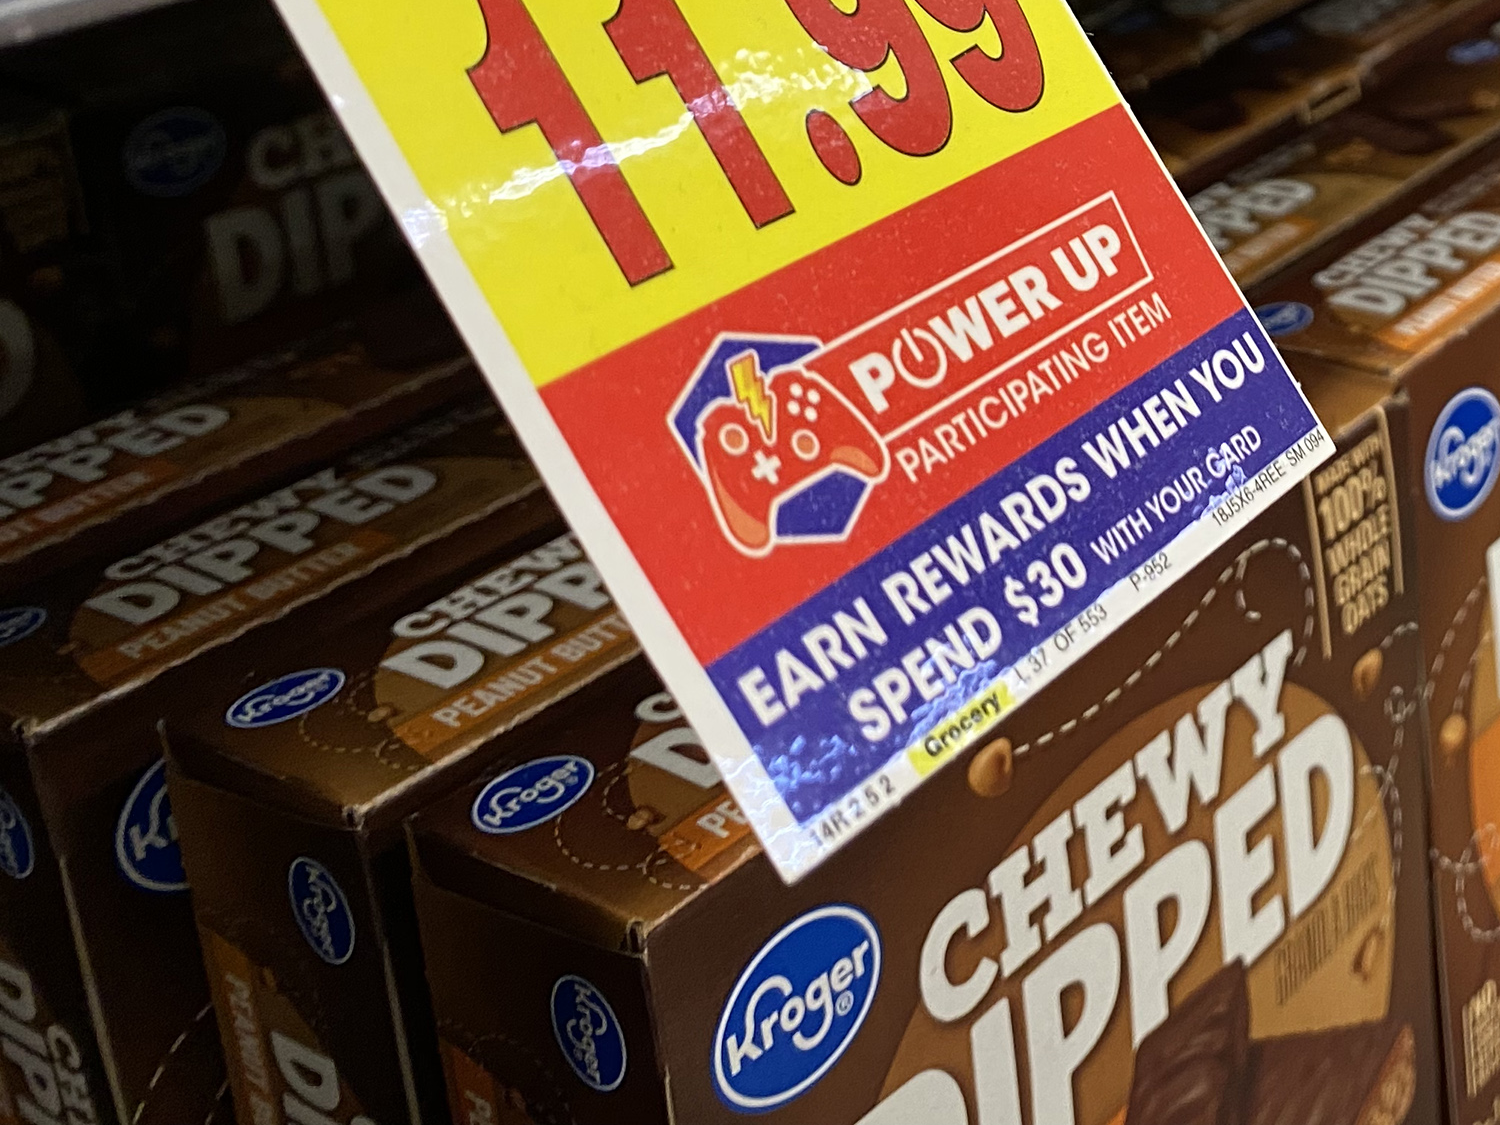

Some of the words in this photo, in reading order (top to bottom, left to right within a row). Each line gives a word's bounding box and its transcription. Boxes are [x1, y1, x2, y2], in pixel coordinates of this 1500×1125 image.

[202, 177, 389, 325] DIP
[849, 265, 1063, 415] POWER
[1050, 223, 1122, 292] UP
[895, 328, 1111, 484] PARTICIPATING
[1107, 291, 1172, 349] ITEM
[1285, 443, 1307, 467] SM
[1303, 428, 1325, 453] 094
[83, 463, 438, 627] DIPPED
[391, 532, 584, 639] CHEW
[737, 595, 889, 727] EARN
[881, 455, 1093, 627] REWARDS
[1082, 378, 1202, 481] WHEN
[1188, 330, 1267, 405] YOU
[848, 606, 1003, 742] SPEND
[1004, 541, 1087, 628] $30
[1089, 507, 1153, 565] WITH
[1144, 466, 1208, 523] YOUR
[1205, 426, 1262, 479] CARD
[379, 561, 612, 690] DIPP
[431, 655, 559, 728] PEANUT
[550, 614, 632, 663] BUTT
[1053, 624, 1076, 652] OF
[483, 759, 580, 826] Kroger
[924, 691, 1001, 757] Grocery
[920, 628, 1295, 1024] CHEWY
[856, 713, 1354, 1125] IPPED
[725, 937, 872, 1075] Kroger
